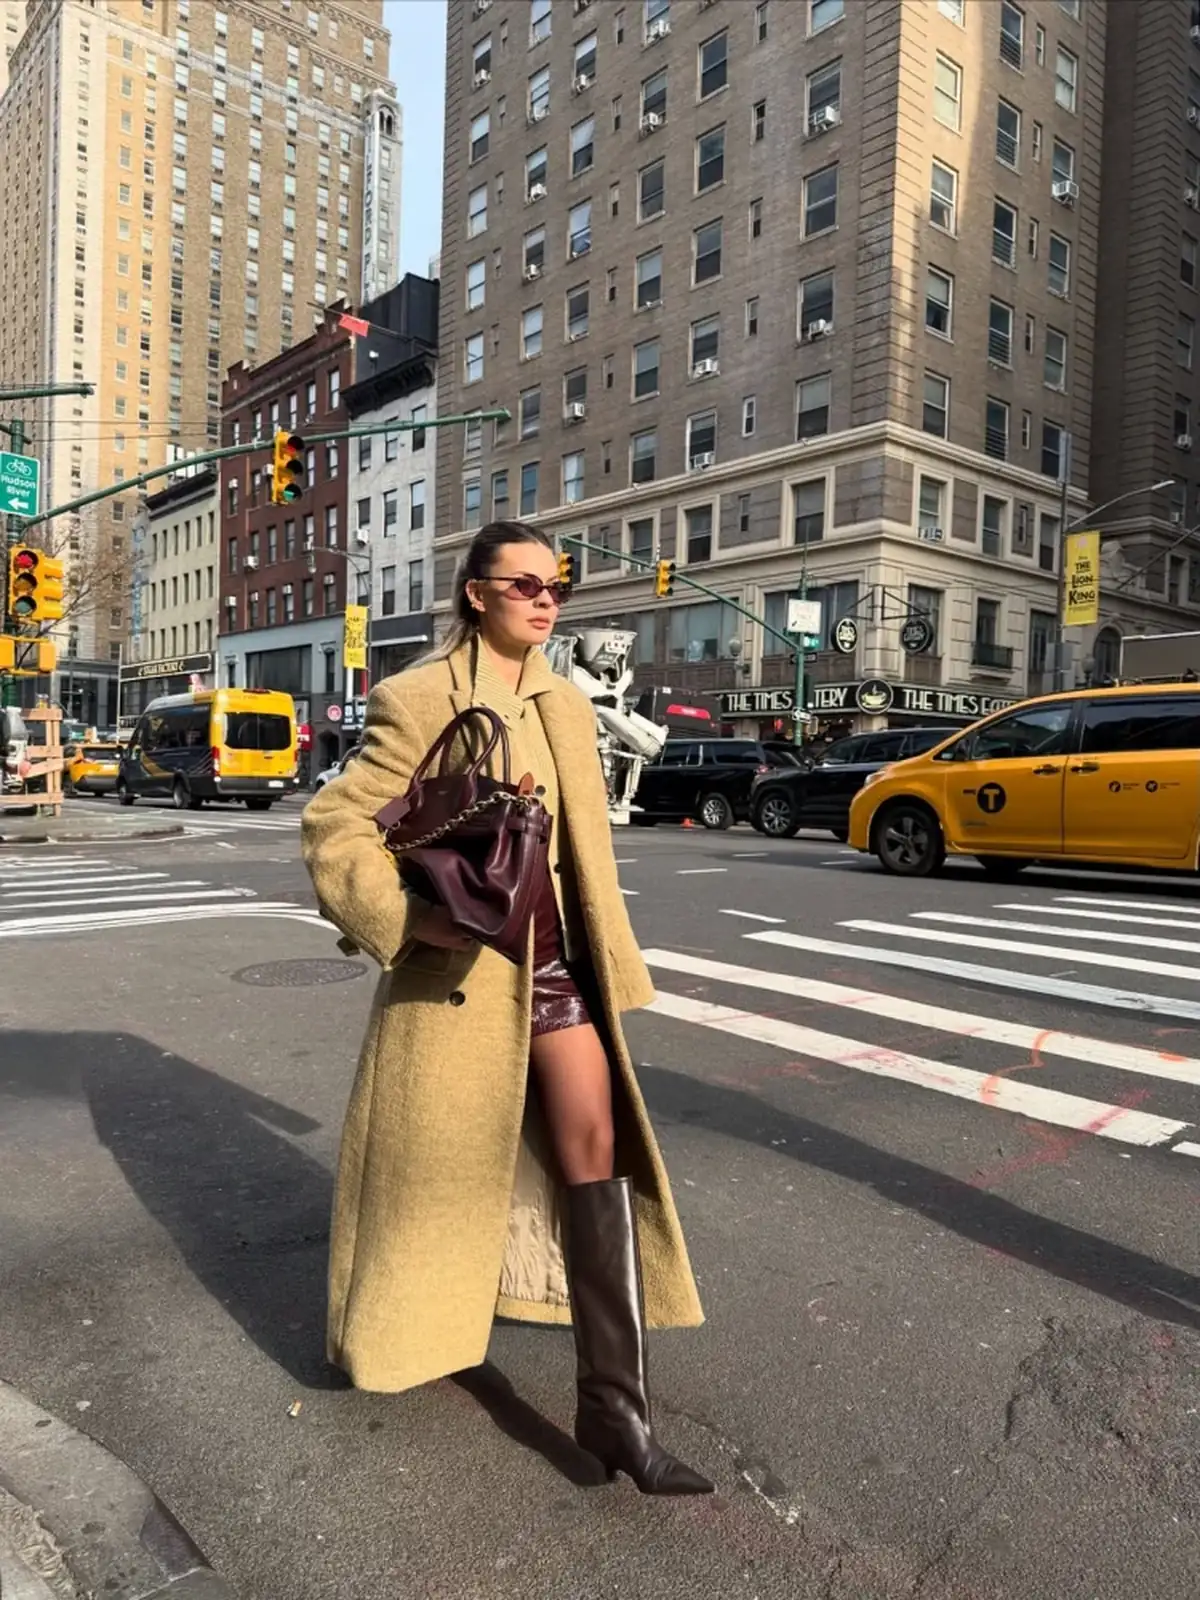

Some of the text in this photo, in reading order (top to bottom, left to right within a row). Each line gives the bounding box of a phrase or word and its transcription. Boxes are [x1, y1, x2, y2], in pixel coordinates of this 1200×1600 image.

[0, 474, 36, 489] Hudson
[6, 485, 31, 498] River
[1075, 561, 1091, 571] THE
[1068, 590, 1096, 606] KING
[726, 693, 752, 711] THE
[753, 690, 793, 710] TIMES
[902, 688, 934, 711] THE
[936, 691, 979, 715] TIMES
[983, 787, 1001, 811] T
